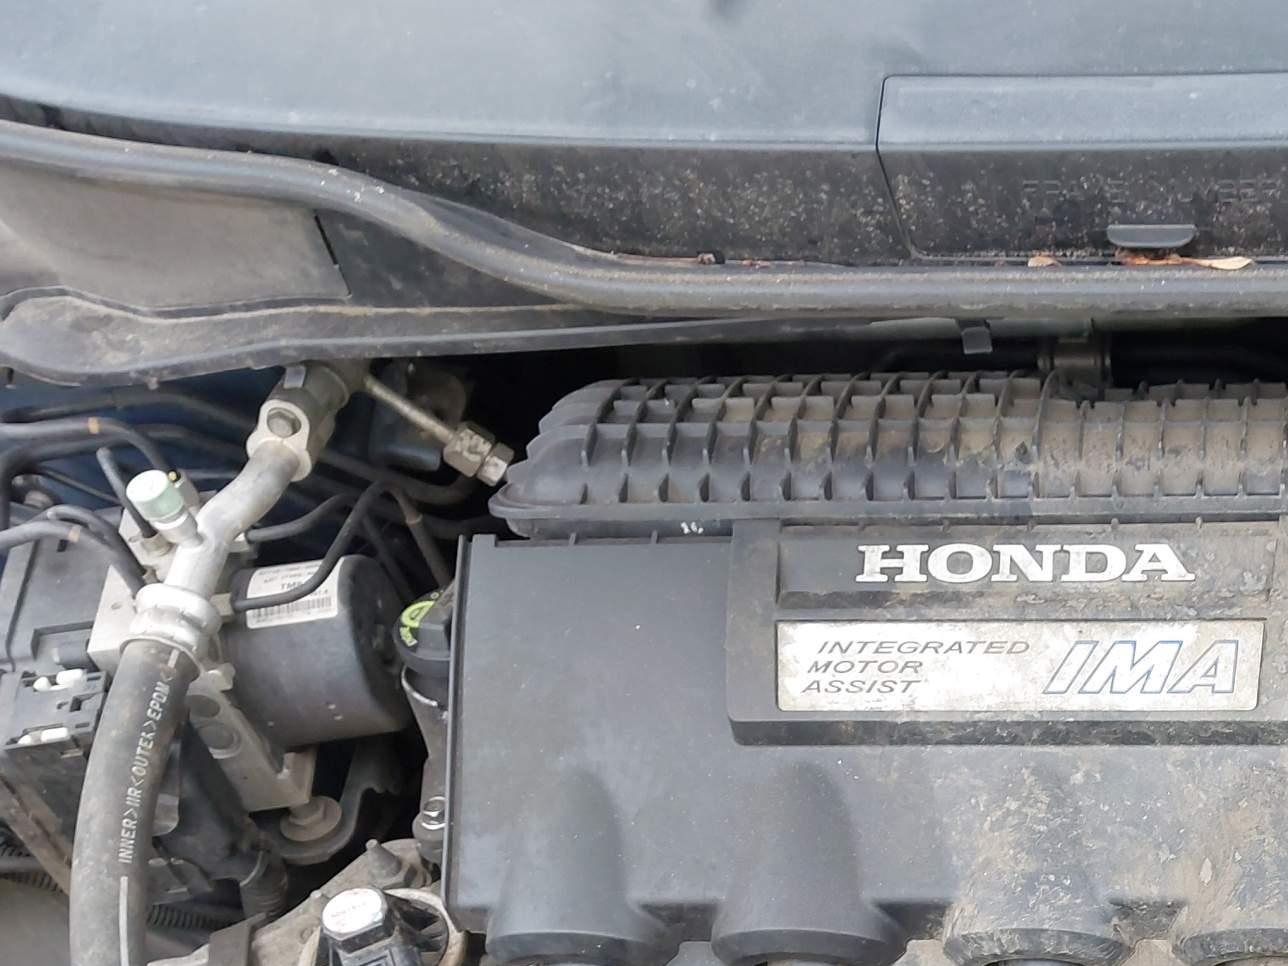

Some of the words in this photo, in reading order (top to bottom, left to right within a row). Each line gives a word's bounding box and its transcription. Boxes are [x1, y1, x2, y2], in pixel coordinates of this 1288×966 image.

[855, 543, 1196, 584] HONDA
[816, 640, 1030, 656] INTEGRATED
[807, 660, 924, 674] MOTOR
[1042, 639, 1239, 695] IMA
[801, 679, 921, 694] ASSIST
